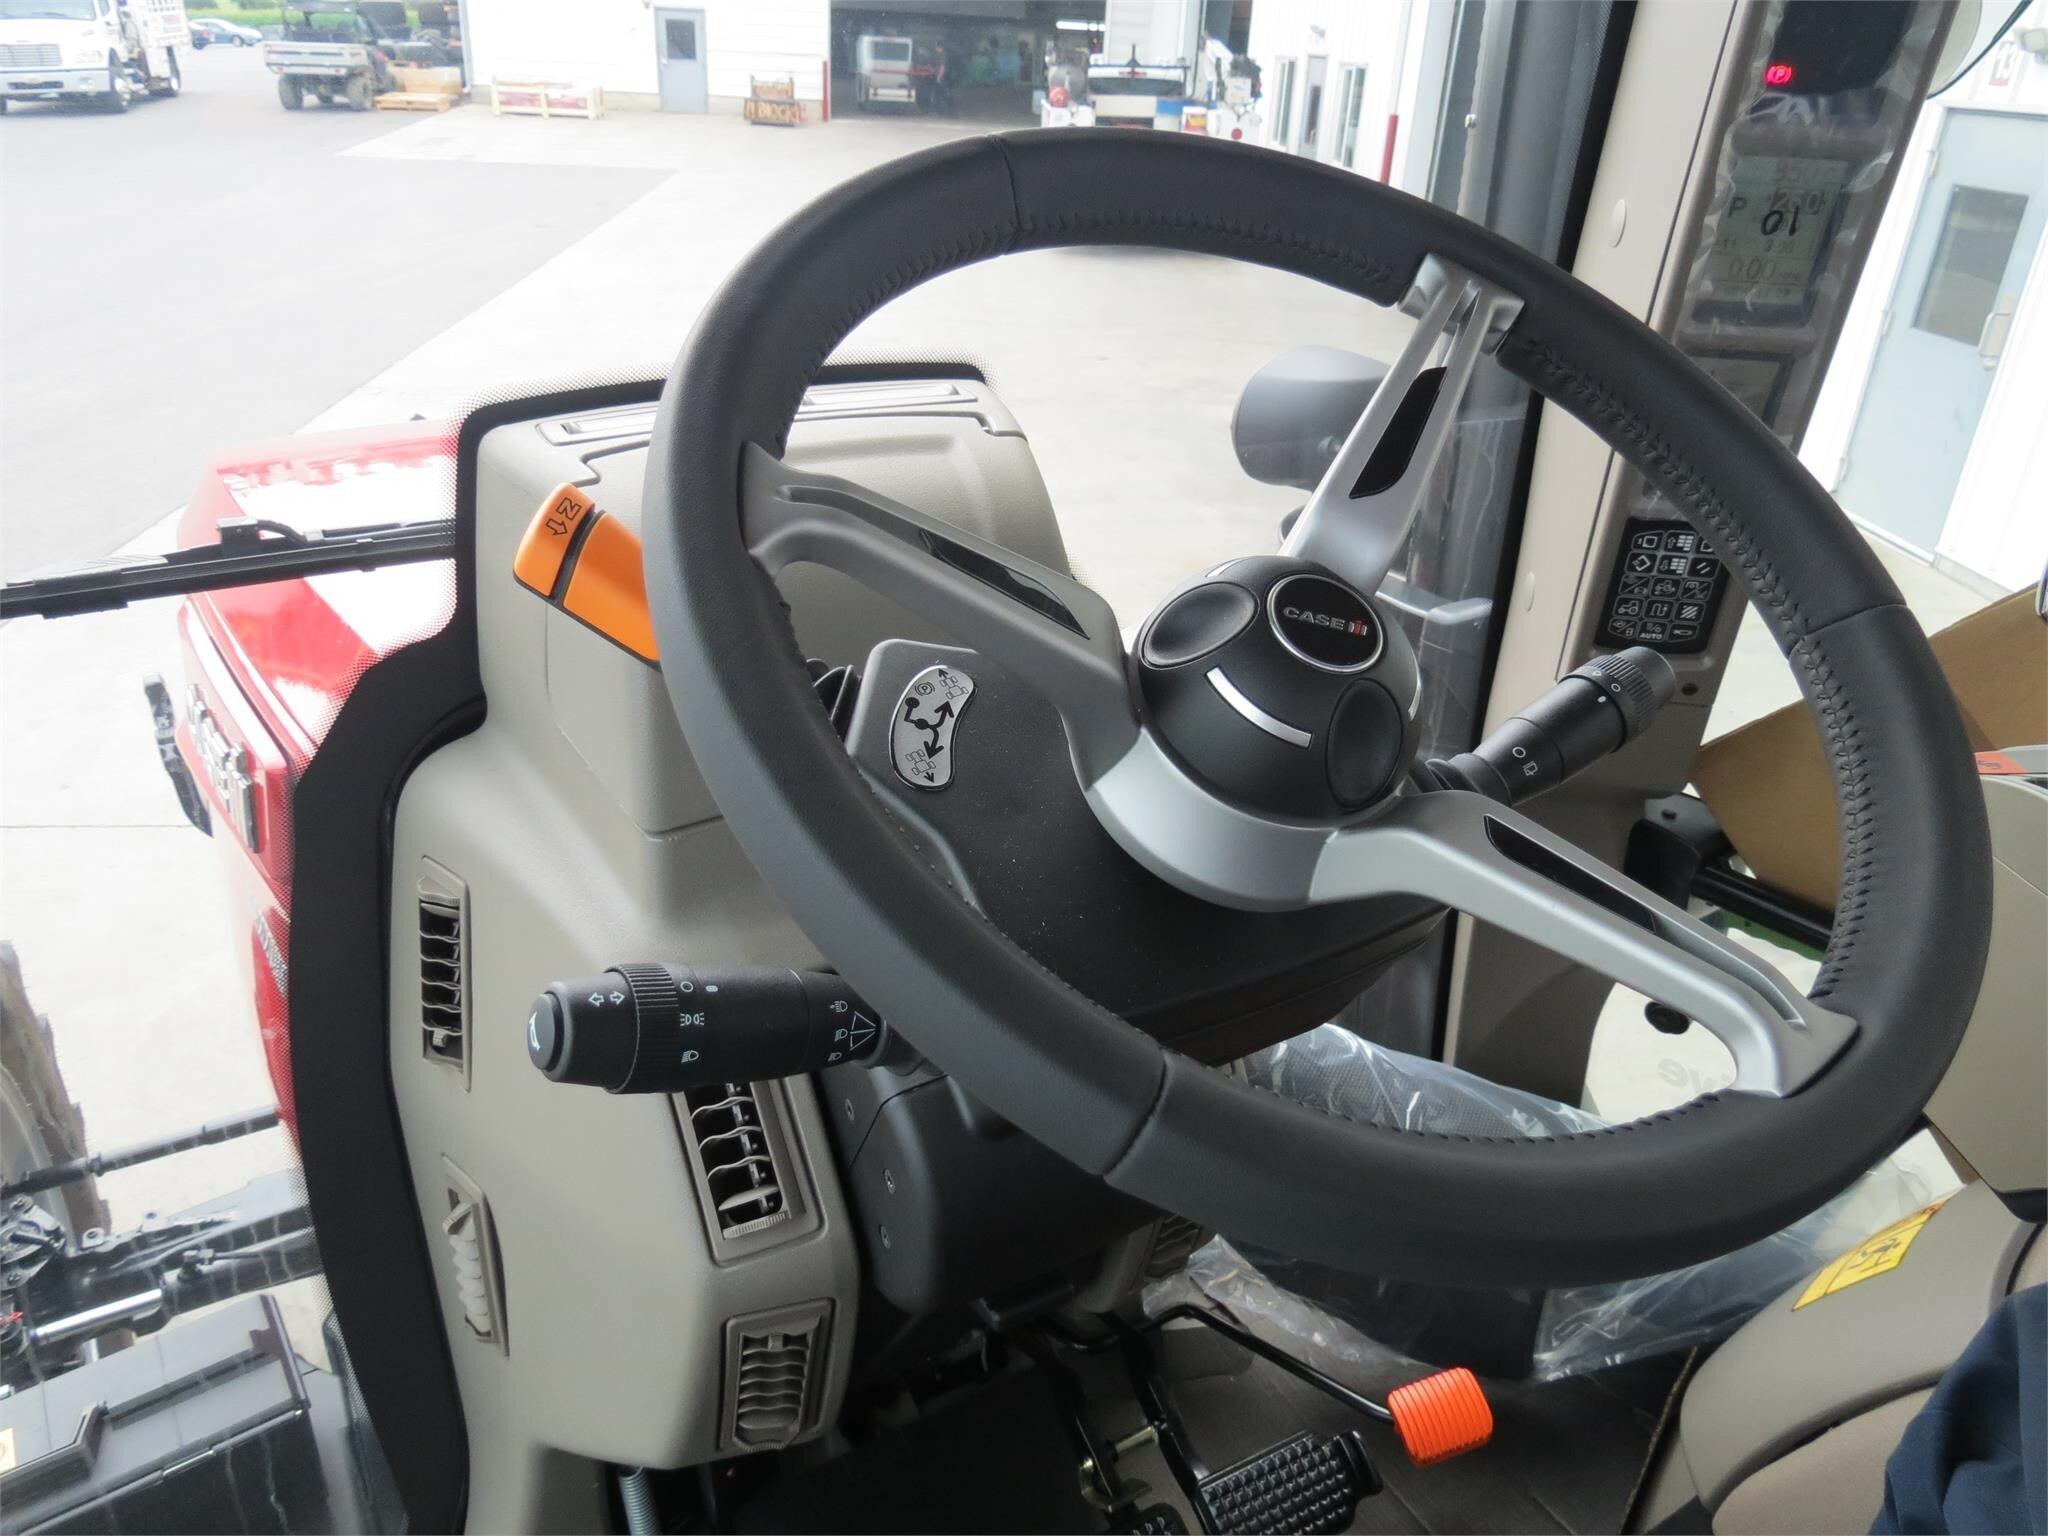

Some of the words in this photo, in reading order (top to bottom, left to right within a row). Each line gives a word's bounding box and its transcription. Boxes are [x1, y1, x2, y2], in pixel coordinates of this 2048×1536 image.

[1728, 197, 1748, 218] P
[556, 497, 582, 520] N
[1283, 606, 1345, 630] CASE
[1640, 632, 1662, 640] AUTO
